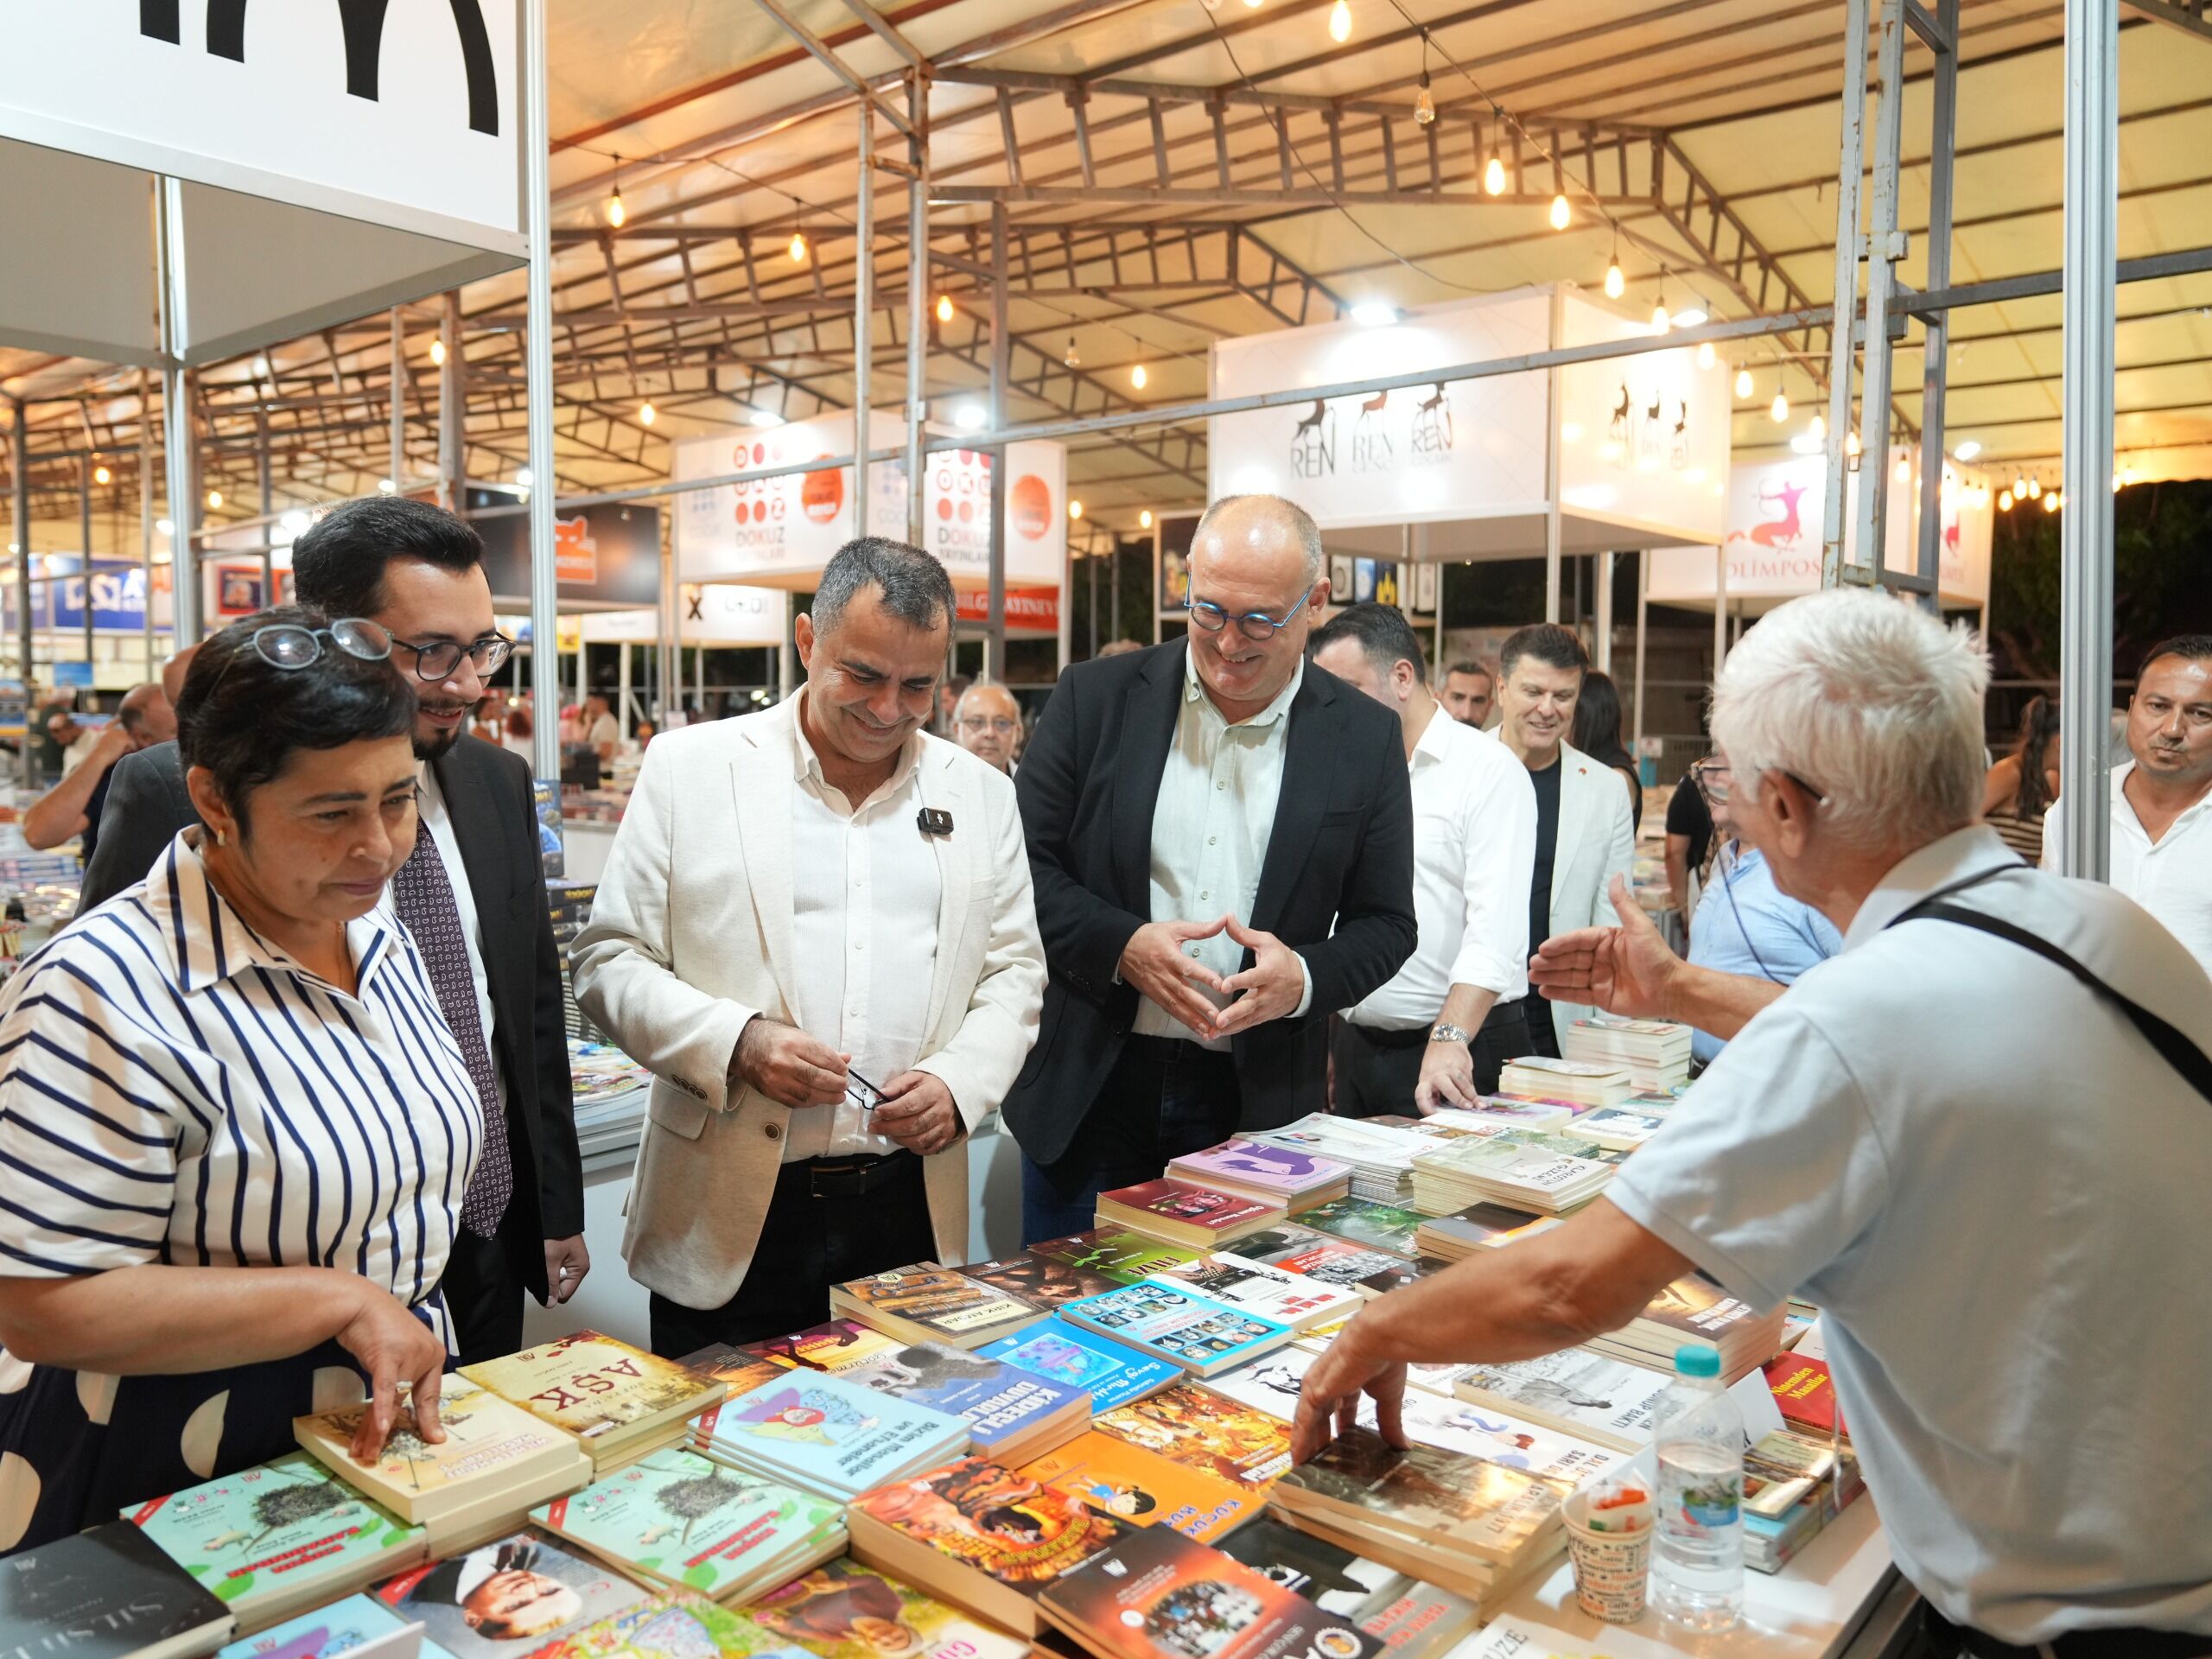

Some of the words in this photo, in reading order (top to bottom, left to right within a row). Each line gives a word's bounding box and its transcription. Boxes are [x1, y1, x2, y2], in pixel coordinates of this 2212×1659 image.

[524, 1357, 655, 1414] AŞK
[1117, 1361, 1166, 1382] Sevgi
[1771, 1367, 1815, 1396] Ninemden
[1788, 1373, 1827, 1400] Masallar
[891, 1419, 918, 1433] ve
[1609, 1407, 1644, 1429] BAKTI
[896, 1420, 942, 1445] Bizim
[831, 1429, 900, 1467] Efsaneler
[839, 1440, 906, 1478] Masallar
[1501, 1482, 1550, 1516] ARALIK
